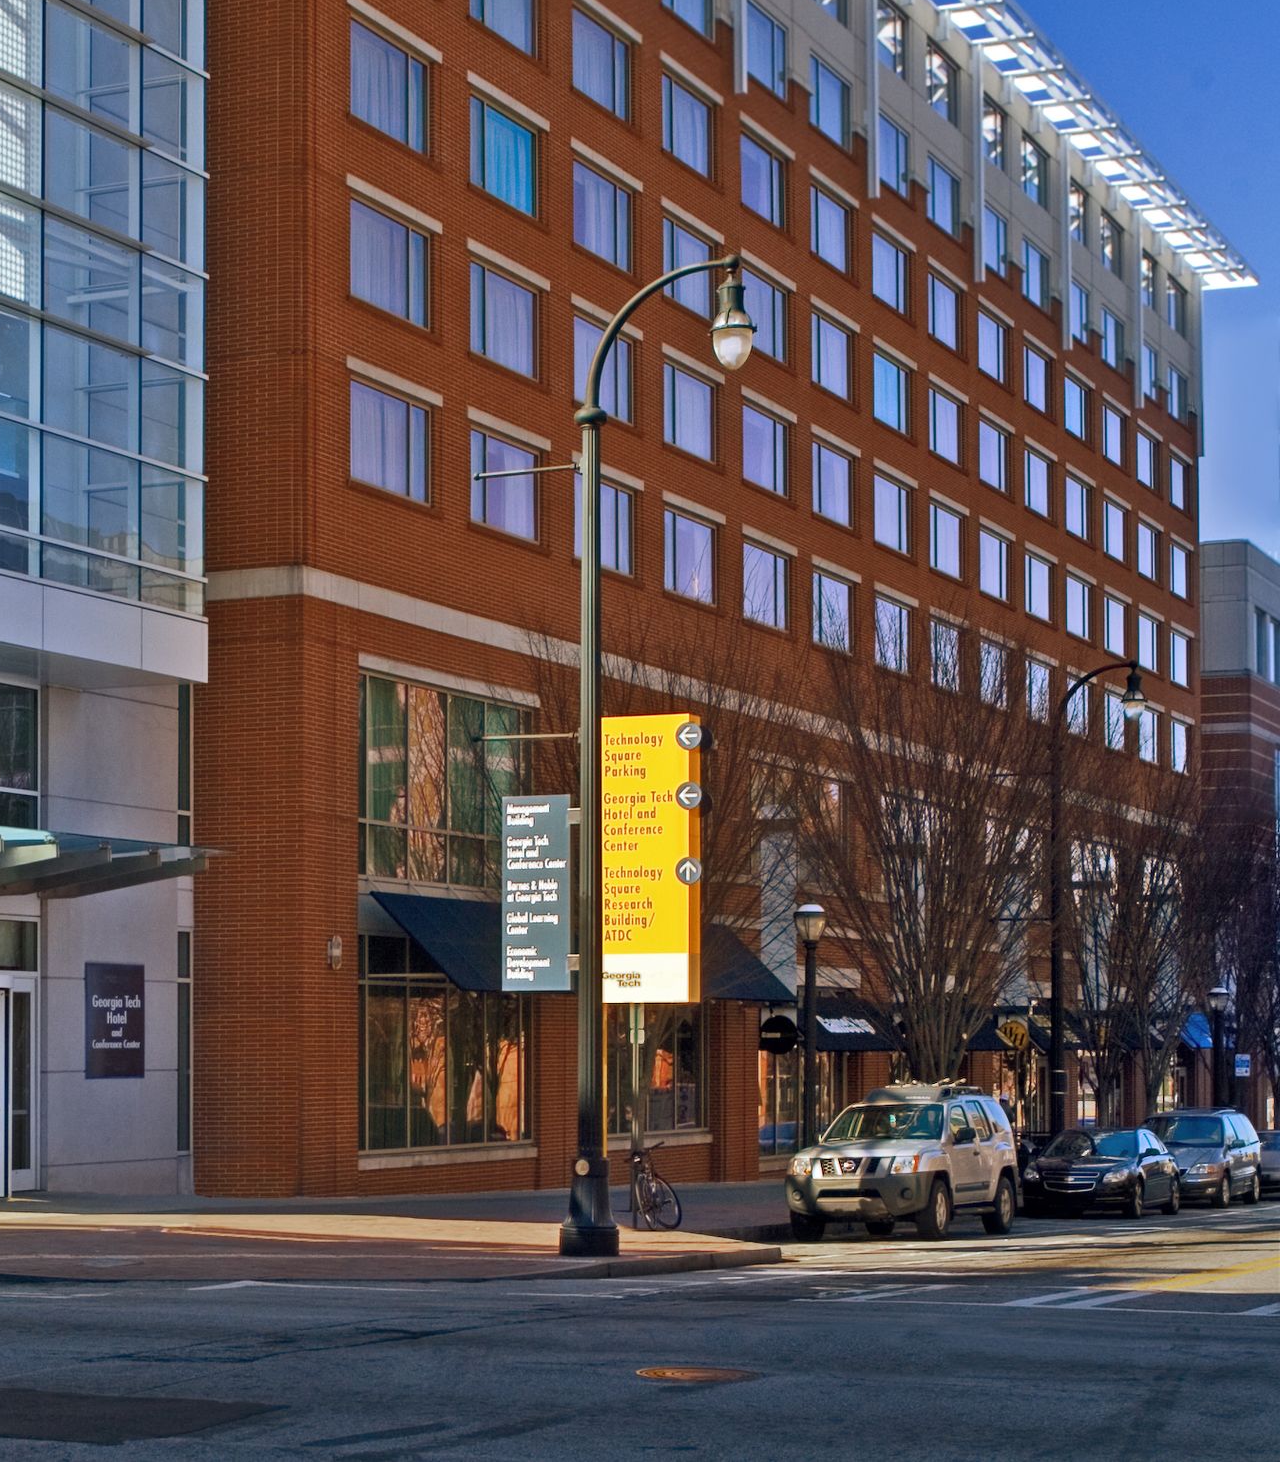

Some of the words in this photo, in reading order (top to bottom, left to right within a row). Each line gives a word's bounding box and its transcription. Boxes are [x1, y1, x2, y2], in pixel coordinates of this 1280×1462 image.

[604, 732, 663, 748] Technology
[604, 750, 642, 764] Square
[604, 764, 646, 779] Parking
[604, 792, 646, 807] Georgia
[651, 789, 673, 803] Tech
[604, 807, 632, 820] Hotel
[637, 806, 656, 819] and
[604, 823, 663, 836] Conference
[506, 836, 533, 848] Georgia
[534, 834, 549, 846] Tech
[604, 840, 639, 851] Center
[526, 846, 539, 857] and
[506, 858, 544, 870] Conference
[544, 858, 567, 868] Center
[604, 865, 663, 881] Technology
[507, 880, 530, 891] Barnes
[531, 880, 538, 890] &
[538, 878, 558, 890] Noble
[604, 883, 640, 898] Square
[507, 894, 514, 903] at
[515, 892, 542, 904] Georgia
[543, 890, 558, 902] Tech
[604, 897, 652, 910] Research
[506, 912, 528, 924] Global
[529, 912, 559, 925] Learning
[604, 912, 655, 928] Building/
[507, 924, 528, 935] Center
[604, 929, 632, 941] ATDC
[602, 972, 641, 980] Georgia
[92, 994, 123, 1011] Georgia
[124, 994, 141, 1008] Tech
[107, 1011, 127, 1024] Hotel
[111, 1027, 123, 1037] and
[92, 1038, 122, 1049] Conference
[123, 1039, 141, 1049] Center
